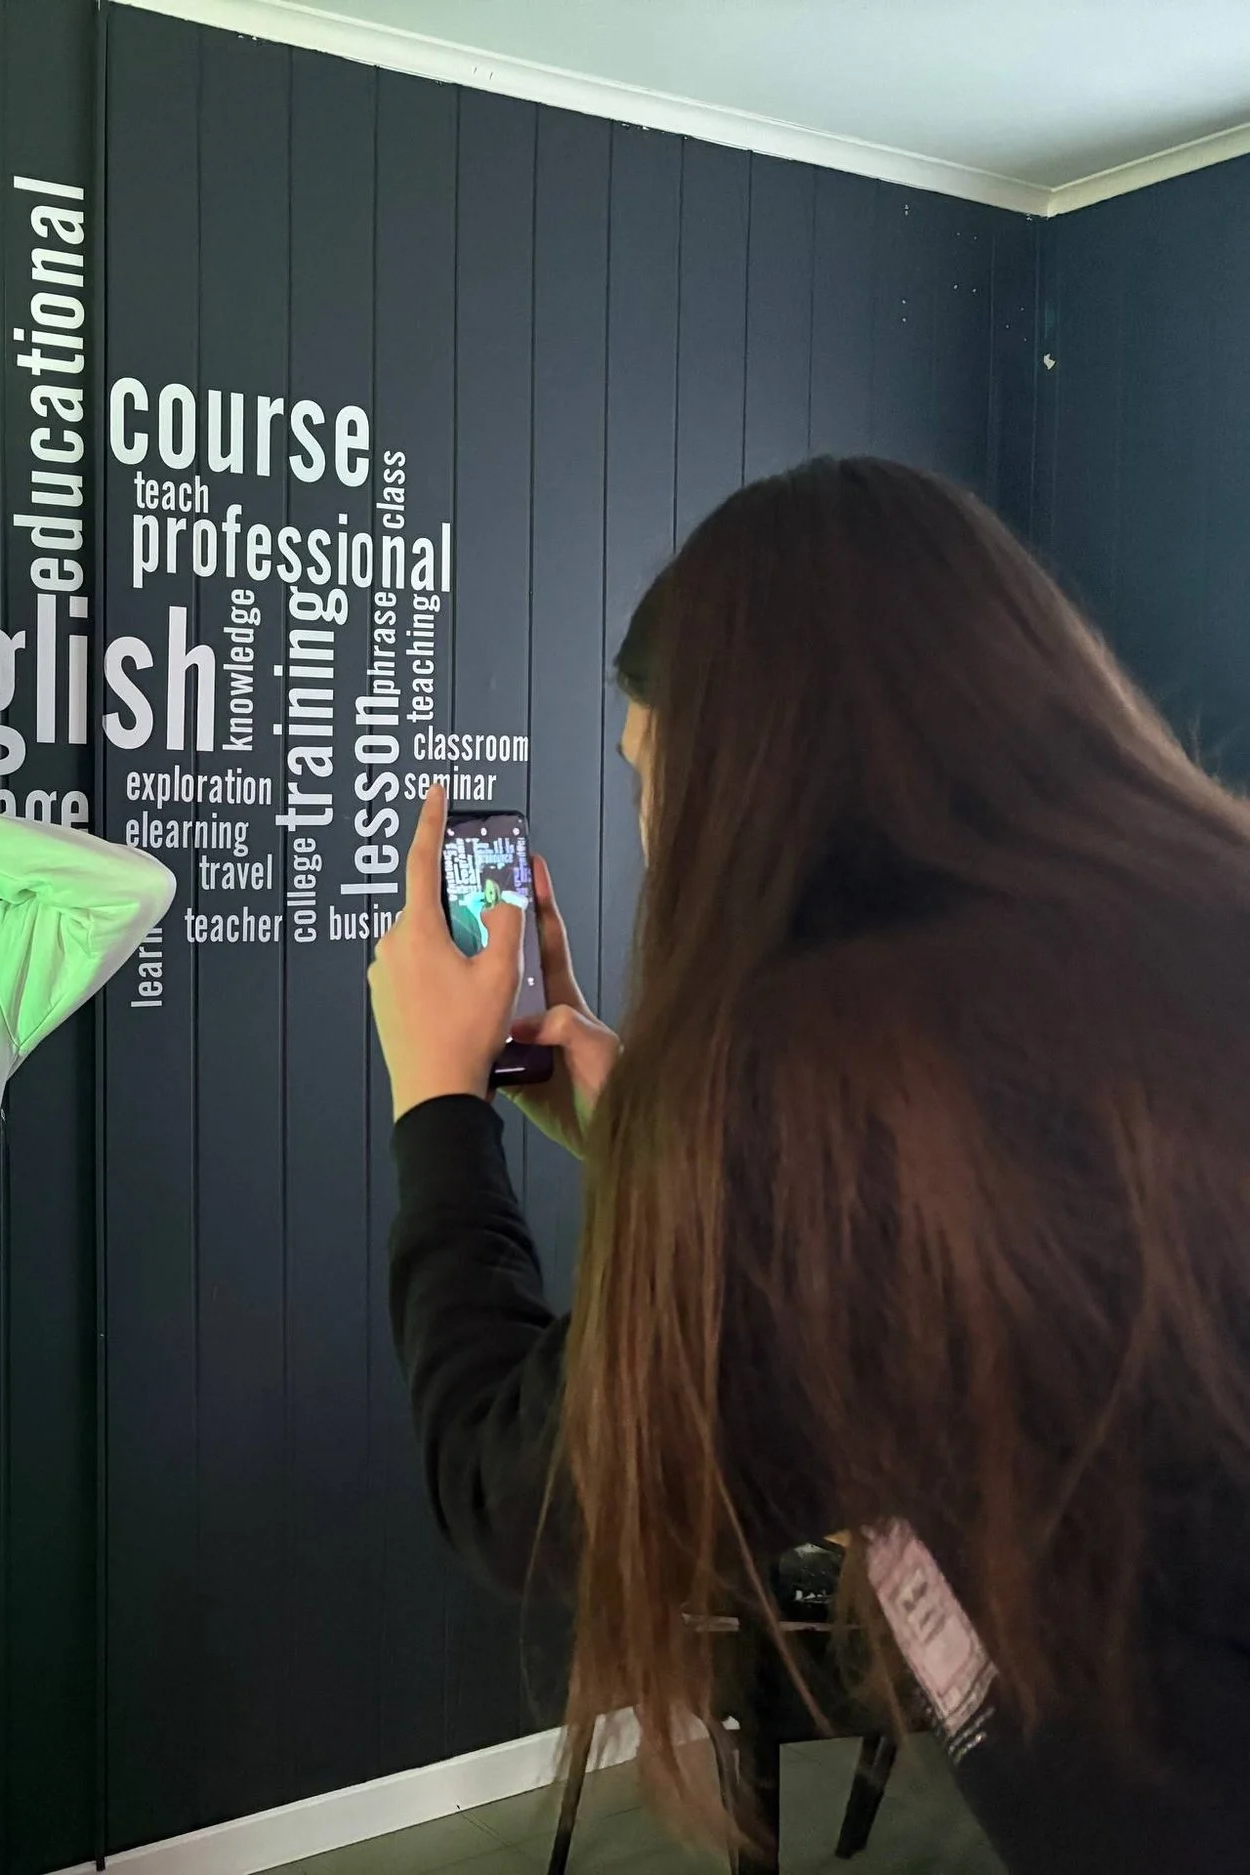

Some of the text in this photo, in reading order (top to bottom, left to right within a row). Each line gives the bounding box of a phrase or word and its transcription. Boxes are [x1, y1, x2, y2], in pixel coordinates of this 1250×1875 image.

[14, 176, 84, 592] educational
[110, 376, 370, 487] course
[134, 470, 209, 514] teach
[376, 450, 406, 530] class
[133, 502, 451, 593] professional
[222, 589, 262, 751] knowledge
[367, 591, 400, 695] phrase
[406, 593, 441, 723] teaching
[273, 585, 349, 832] training
[413, 725, 529, 762] classroom
[126, 765, 272, 810] exploration
[341, 695, 400, 895] lesson
[404, 765, 497, 801] seminar
[126, 811, 249, 858] elearning
[199, 854, 273, 890] travel
[185, 906, 283, 943] teacher
[286, 838, 323, 943] college
[330, 904, 401, 941] busin
